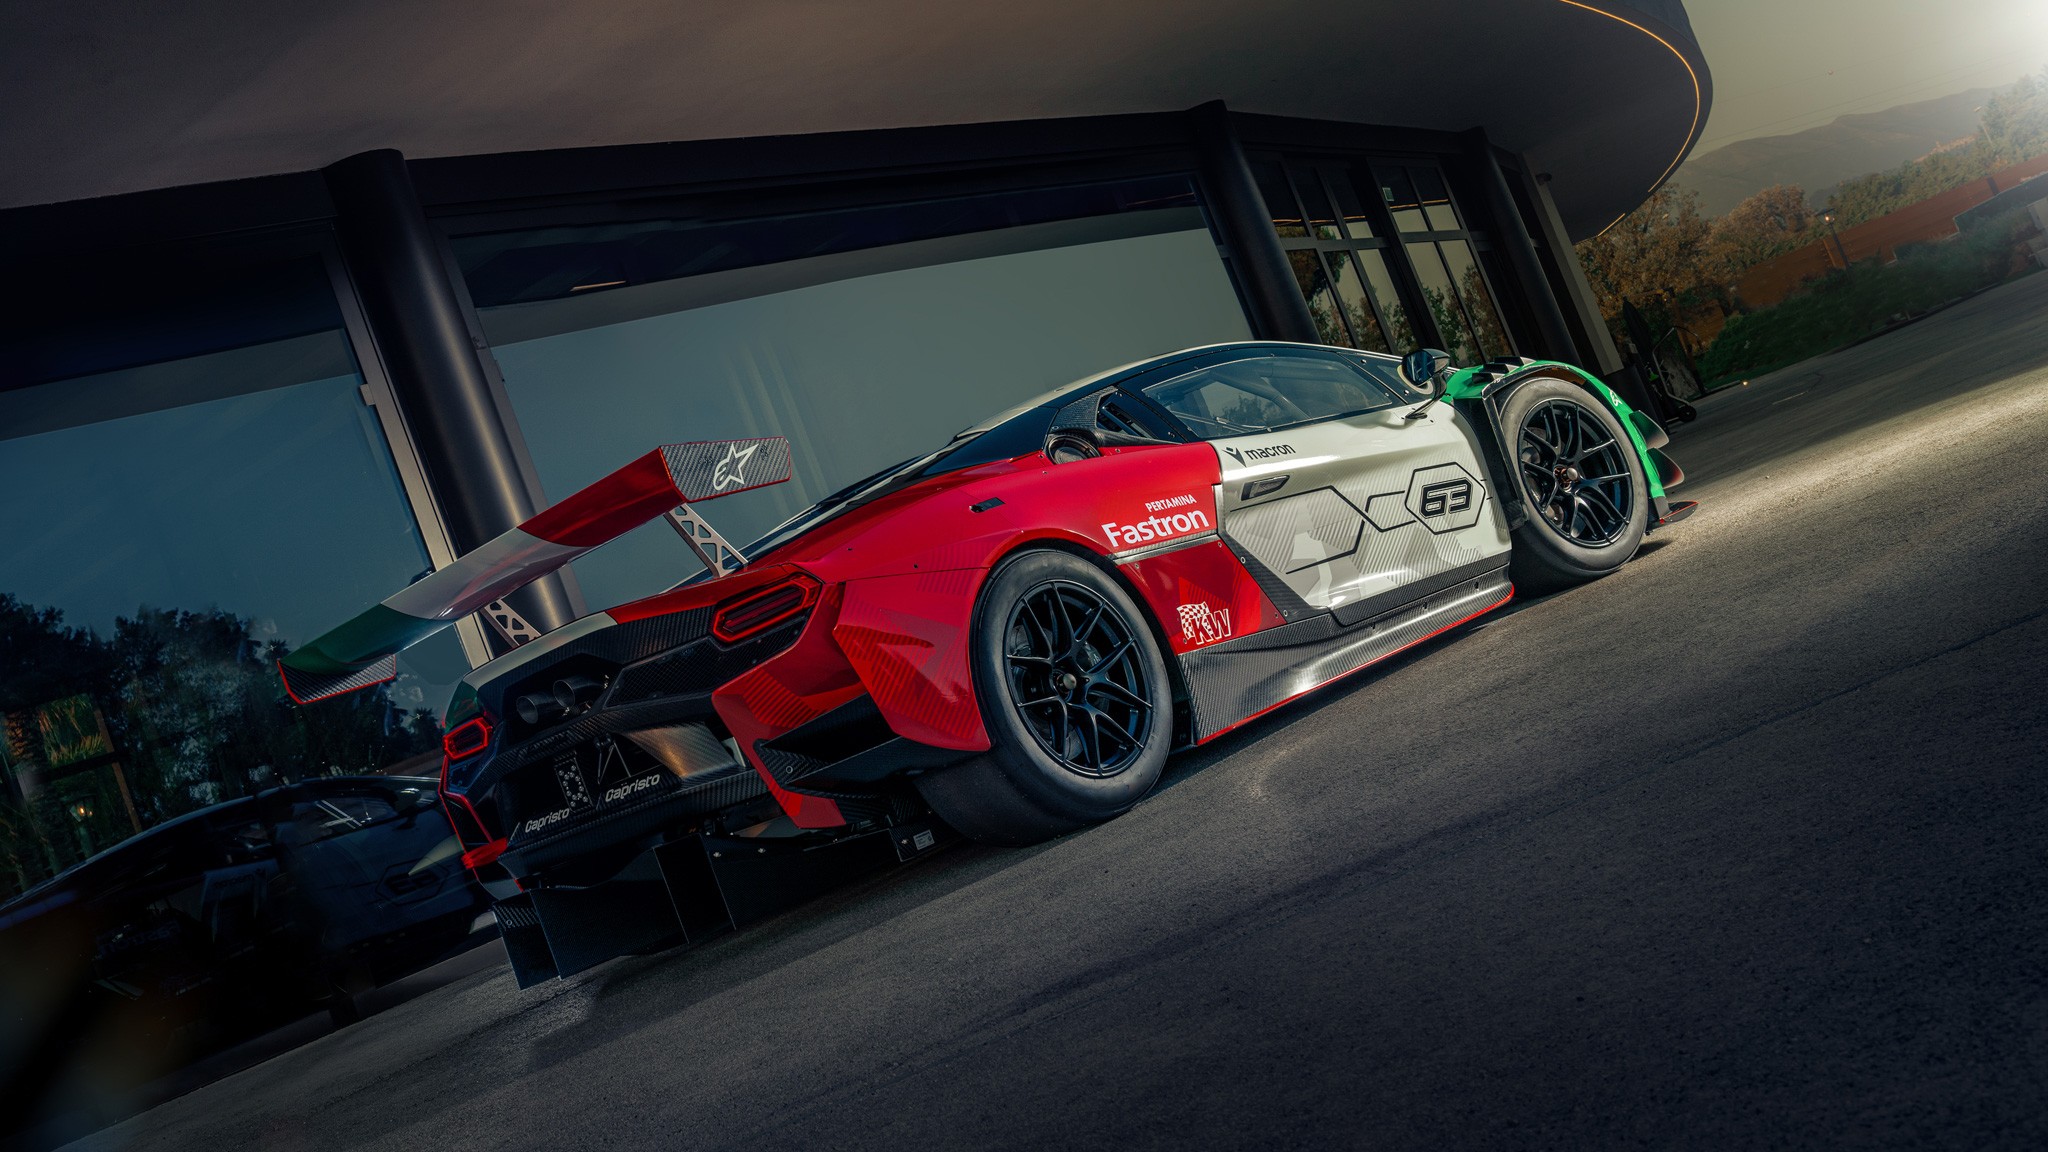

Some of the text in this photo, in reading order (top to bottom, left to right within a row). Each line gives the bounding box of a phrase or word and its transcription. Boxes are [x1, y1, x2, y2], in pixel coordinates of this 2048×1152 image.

[1244, 444, 1296, 460] macron
[1145, 494, 1197, 512] PERTAMINA
[1420, 477, 1473, 519] 63
[1101, 510, 1209, 547] Fastron
[1190, 608, 1231, 645] KW
[605, 774, 660, 802] Capristo
[525, 807, 570, 833] Capristo
